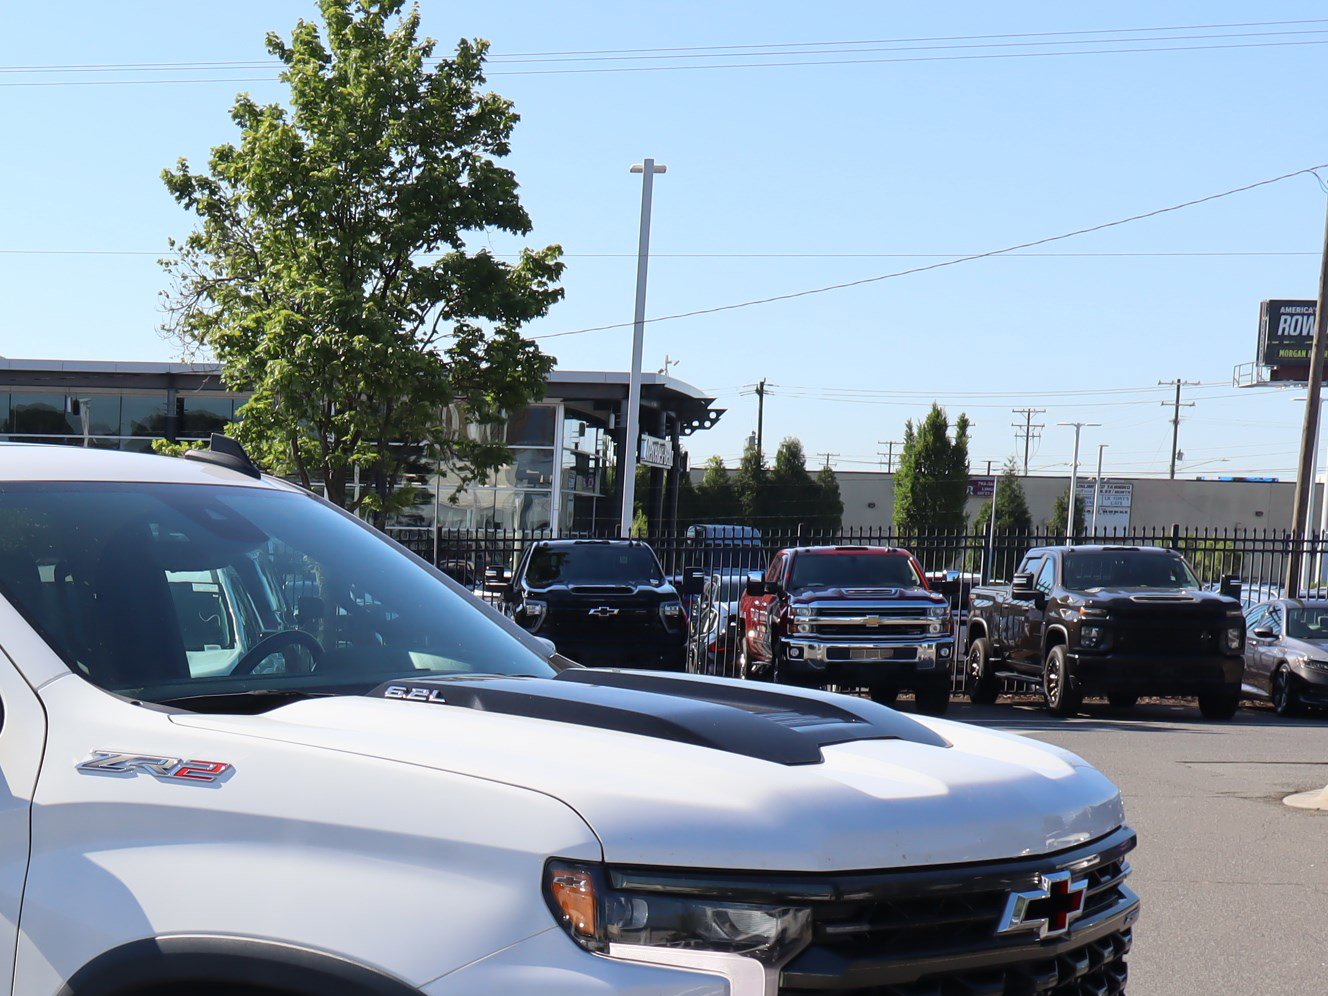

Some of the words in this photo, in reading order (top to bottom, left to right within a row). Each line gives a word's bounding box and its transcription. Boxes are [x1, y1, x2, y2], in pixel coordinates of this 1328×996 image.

[1280, 306, 1317, 314] AMERICA'
[1279, 349, 1307, 358] MORGAN
[384, 685, 446, 703] 6.2L
[76, 750, 235, 786] ZR2
